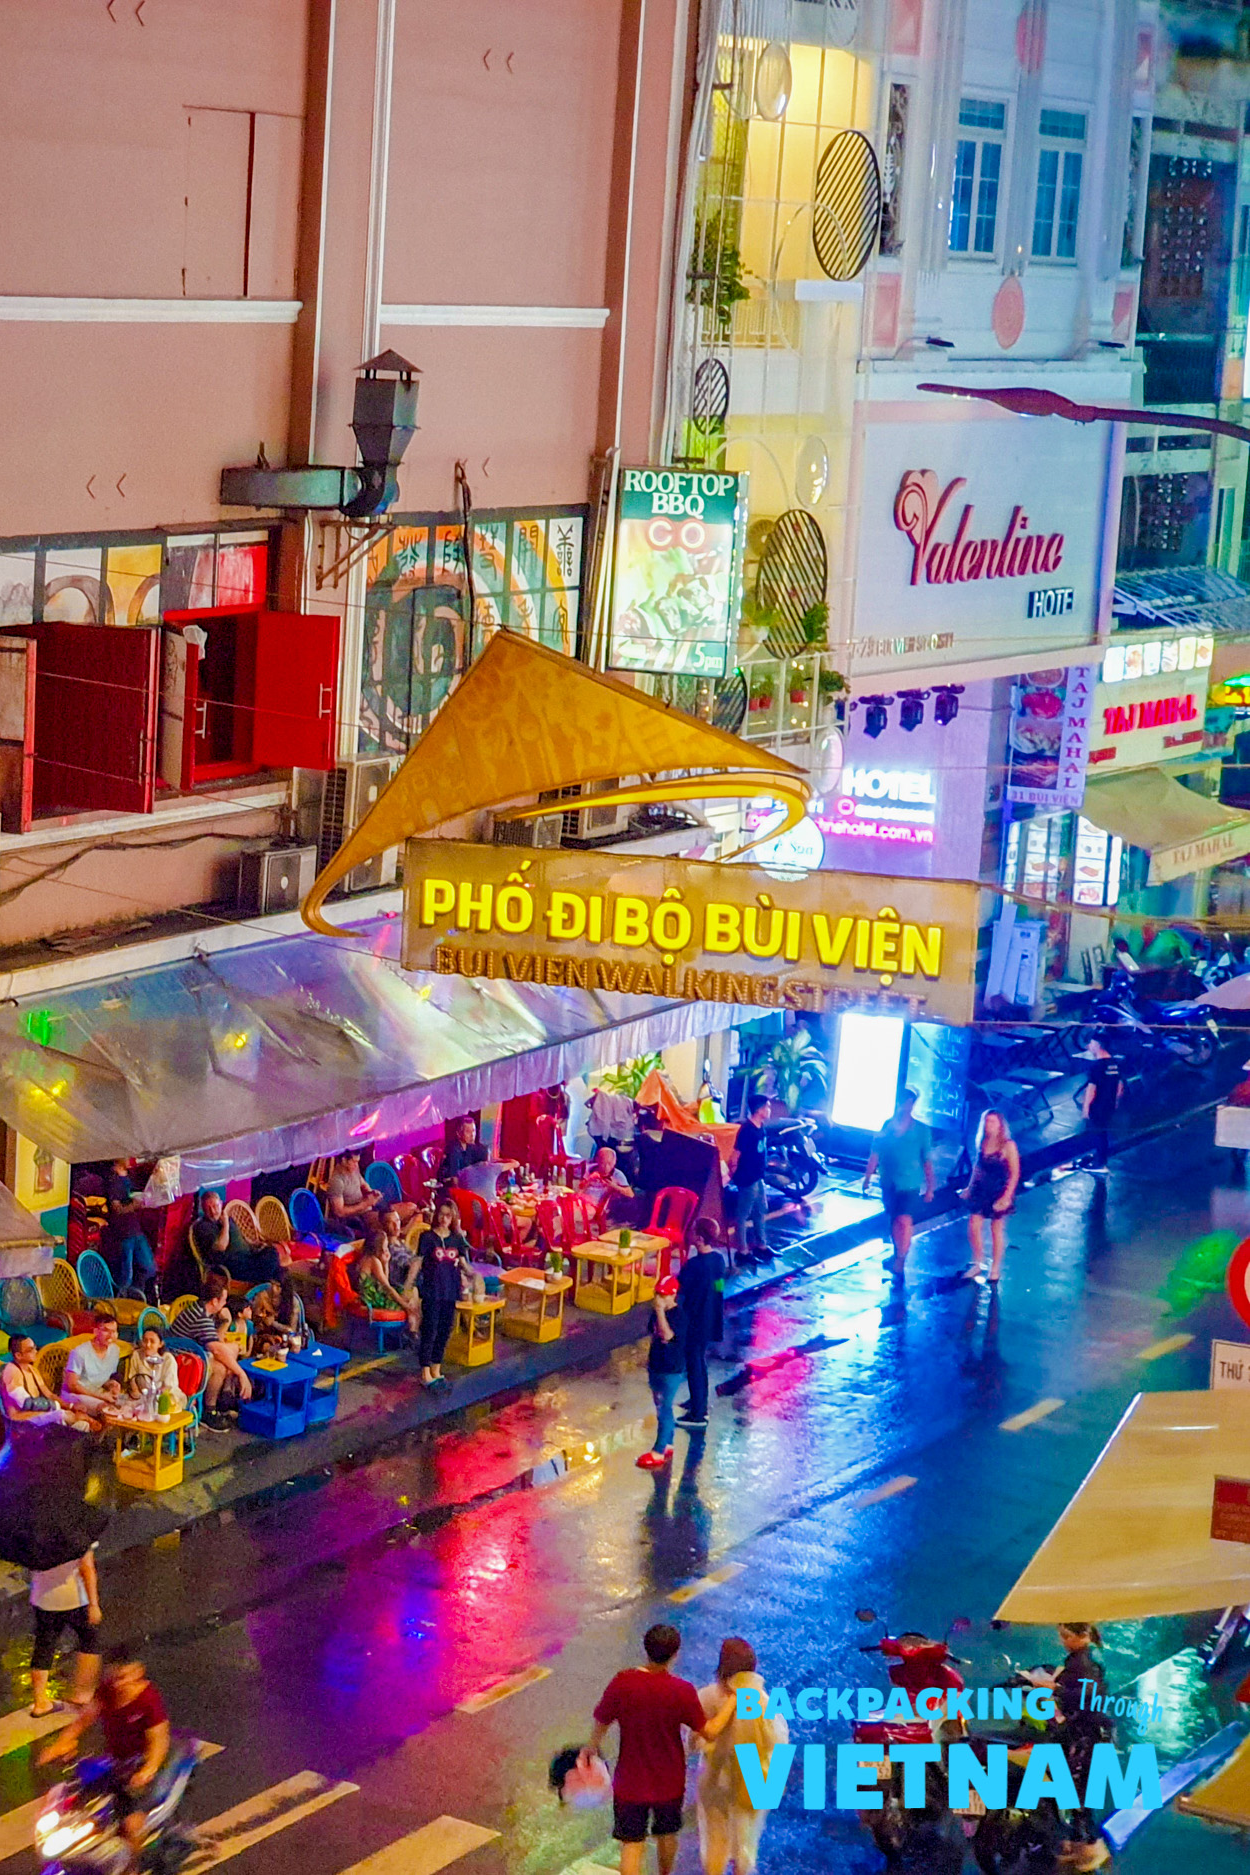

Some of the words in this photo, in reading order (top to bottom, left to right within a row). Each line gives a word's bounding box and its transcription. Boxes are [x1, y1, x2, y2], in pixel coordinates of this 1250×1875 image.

[624, 470, 735, 496] ROOFTOP
[651, 493, 705, 519] BBQ
[895, 470, 1064, 586] Valentine
[1070, 667, 1091, 709] TAJ
[1063, 716, 1087, 789] MAHAL
[842, 768, 935, 803] HOTEL
[421, 860, 534, 934] PHỐ
[546, 890, 603, 944] ĐI
[613, 886, 692, 967] BỘ
[704, 893, 801, 962] BÙI
[813, 906, 943, 988] VIỆN
[435, 946, 495, 981] BUI
[505, 952, 589, 990] VIEN
[596, 960, 778, 1008] WALKING
[779, 981, 927, 1017] STREET
